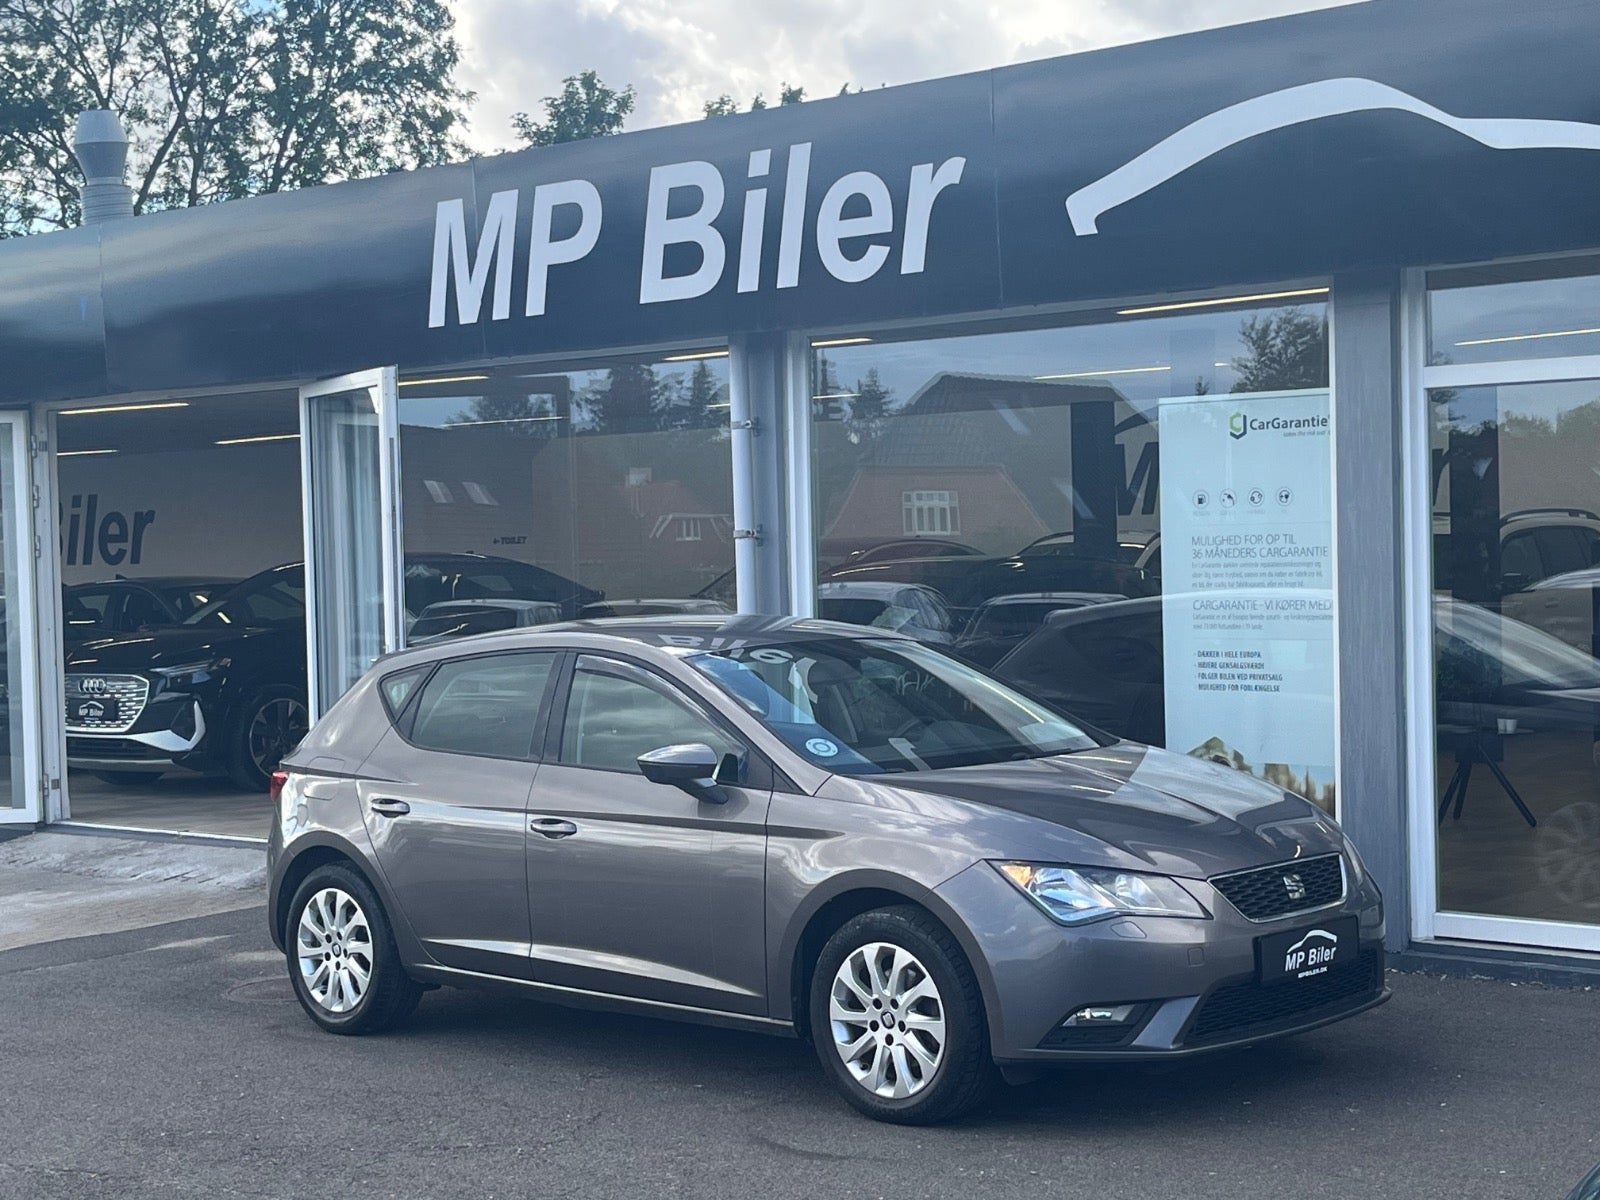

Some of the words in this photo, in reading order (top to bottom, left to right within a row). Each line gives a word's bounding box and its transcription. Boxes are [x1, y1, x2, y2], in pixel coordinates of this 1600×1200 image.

[428, 178, 603, 329] MP
[639, 141, 967, 305] Biler
[1249, 415, 1328, 431] CarGarantie
[59, 493, 156, 566] iler
[1191, 535, 1242, 546] MULIGHED
[1244, 534, 1264, 545] FOR
[1265, 534, 1281, 545] OP
[1283, 533, 1297, 545] TIL
[1191, 548, 1203, 559] 36
[1205, 546, 1258, 559] MÅNEDERS
[1259, 546, 1329, 558] CARGARANTIE
[1192, 600, 1258, 610] CARGARANTIE
[1284, 951, 1305, 972] MP
[1307, 946, 1337, 966] Biler
